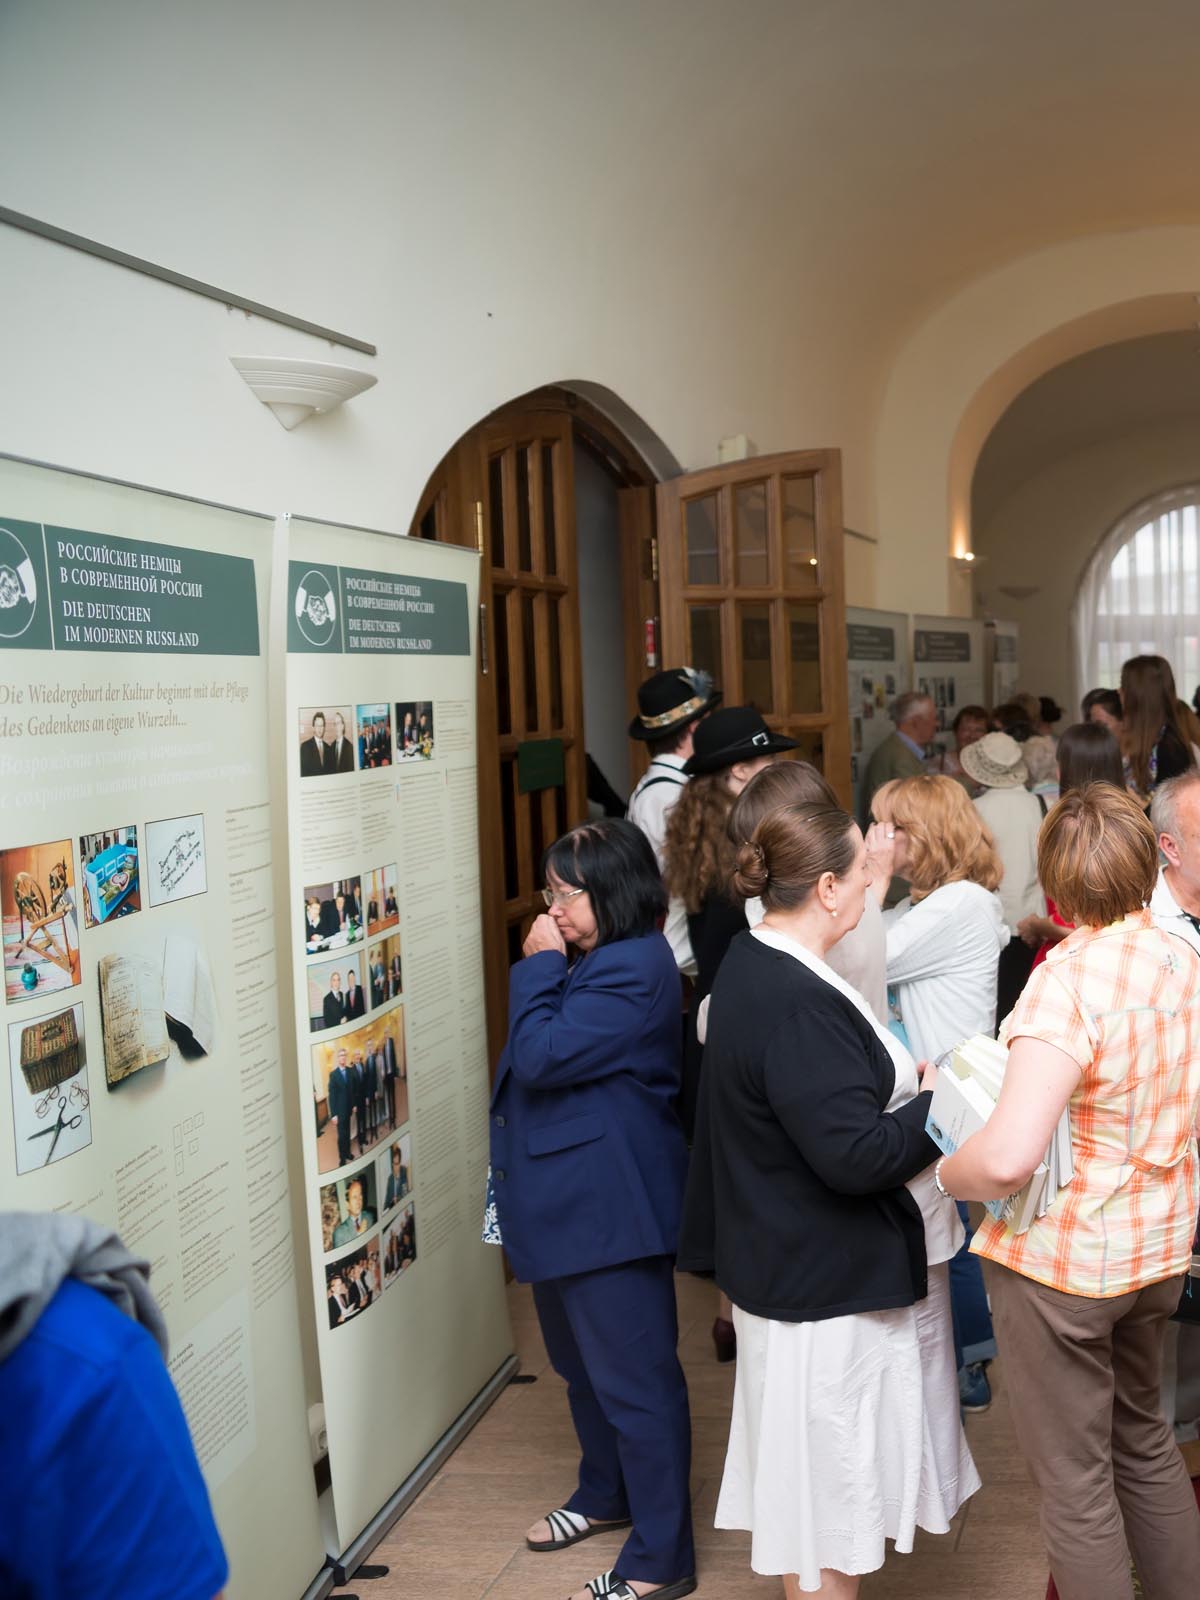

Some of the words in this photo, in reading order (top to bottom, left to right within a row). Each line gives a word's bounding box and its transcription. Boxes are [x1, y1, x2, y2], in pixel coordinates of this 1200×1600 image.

[57, 540, 138, 569] РОССИЙСКИЕ
[140, 554, 182, 576] НЕМЦЫ
[60, 566, 68, 583] В
[71, 568, 158, 593] СОВРЕМЕННОЙ
[160, 579, 203, 598] РОССИИ
[346, 577, 393, 594] РОССИЙСКИЕ
[62, 600, 85, 618] DIE
[87, 602, 151, 623] DEUTSCHEN
[353, 595, 405, 612] СОВРЕМЕННОЙ
[64, 625, 81, 642] IM
[83, 626, 143, 645] MODERNEN
[146, 630, 200, 647] RUSSLAND
[348, 618, 362, 631] DIE
[362, 619, 401, 633] DEUTSCHEN
[349, 636, 360, 648] IM
[360, 636, 396, 649] MODERNEN
[396, 638, 432, 650] RUSSLAND
[28, 682, 103, 709] Wiedergeburt
[105, 681, 121, 702] der
[122, 681, 155, 702] Kultur
[157, 681, 192, 706] beginnt
[194, 682, 208, 699] mit
[210, 680, 225, 698] der
[28, 713, 90, 737] Gedenkens
[92, 719, 104, 733] an
[106, 712, 135, 737] eigene
